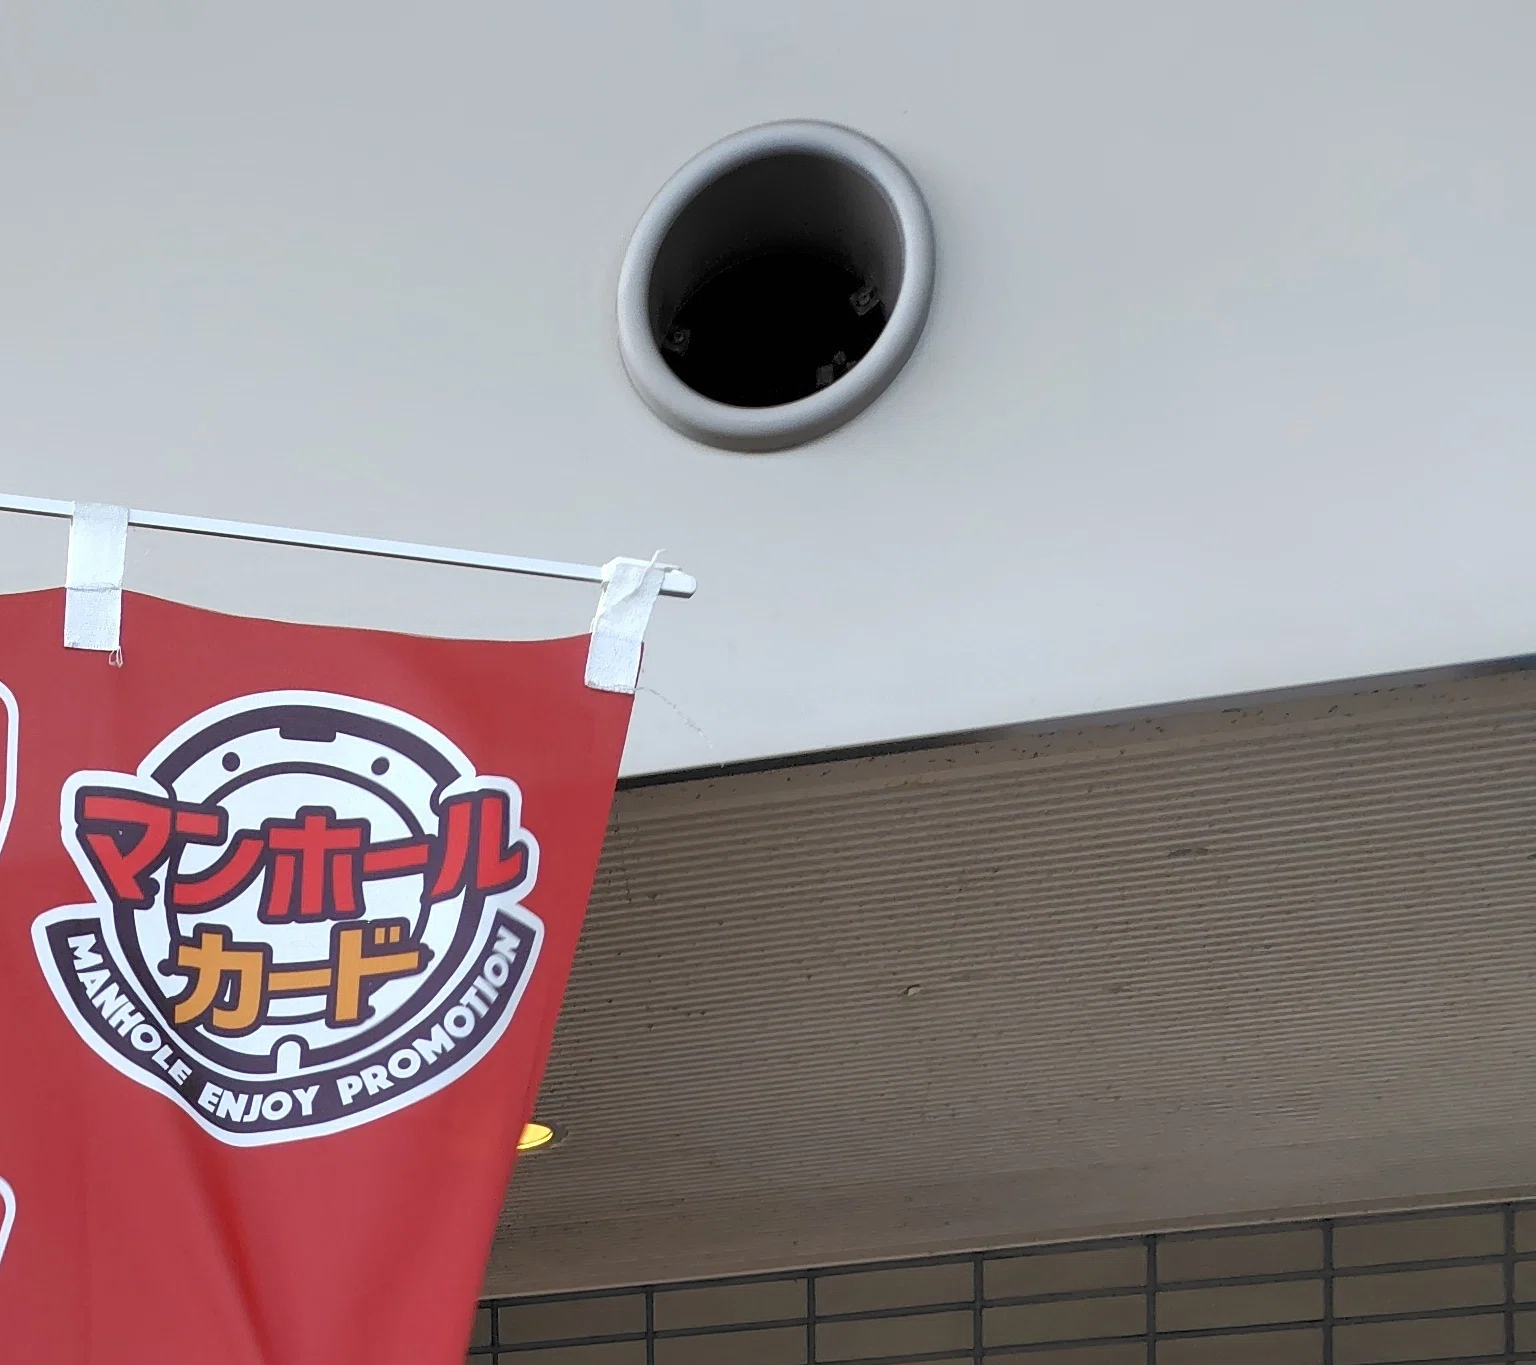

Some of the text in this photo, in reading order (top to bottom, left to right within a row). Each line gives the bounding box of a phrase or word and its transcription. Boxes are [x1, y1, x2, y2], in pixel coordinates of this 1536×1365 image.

[78, 787, 528, 920] マンホール
[66, 927, 521, 1124] MANHOLE ENJOY PROMOTION
[171, 922, 424, 1032] カード
